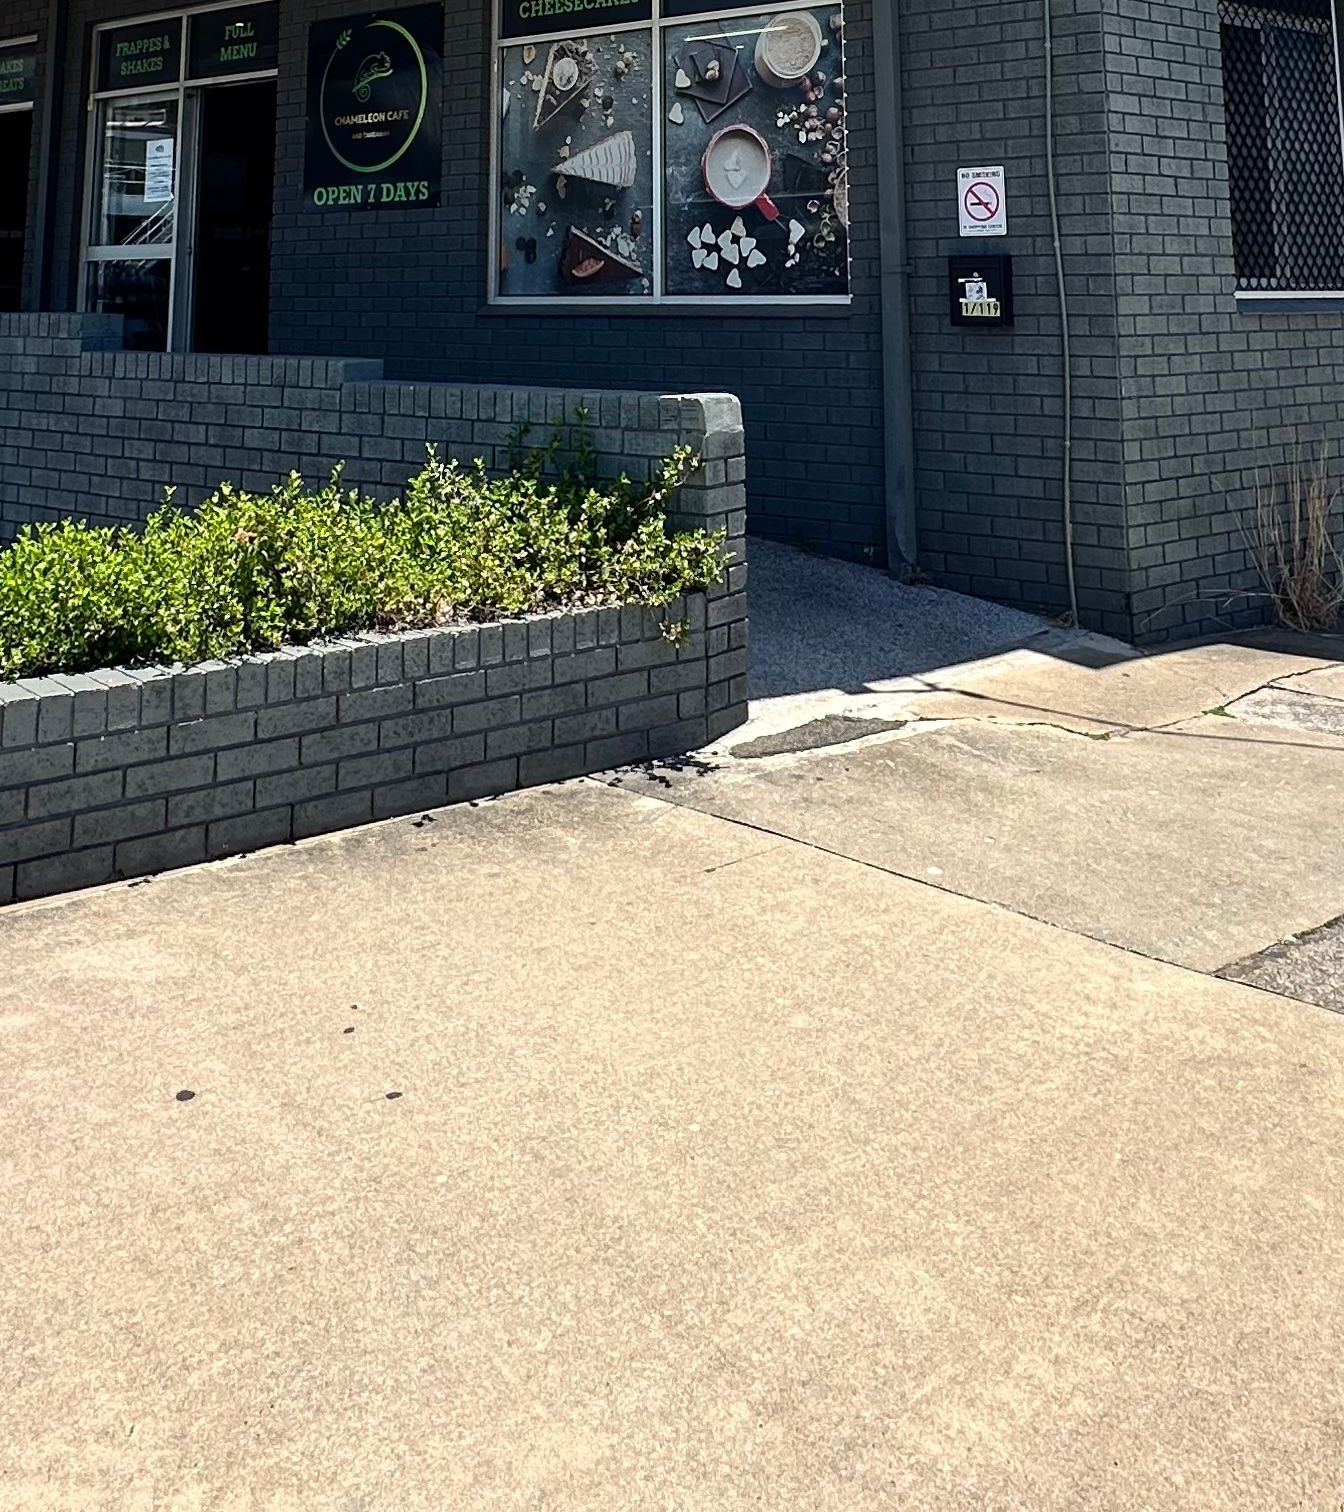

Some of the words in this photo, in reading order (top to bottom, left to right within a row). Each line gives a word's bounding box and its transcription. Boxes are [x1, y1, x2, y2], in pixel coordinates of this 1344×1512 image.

[224, 22, 255, 40] FULL
[116, 37, 163, 57] FRAPPES
[163, 34, 171, 50] &
[220, 42, 257, 62] MENU
[120, 56, 164, 76] SHAKES
[334, 112, 386, 126] CHAMELEON
[386, 109, 409, 121] CAFE
[313, 184, 364, 206] OPEN
[367, 183, 376, 203] 7
[380, 181, 429, 202] DAYS
[963, 302, 999, 316] 1/119
